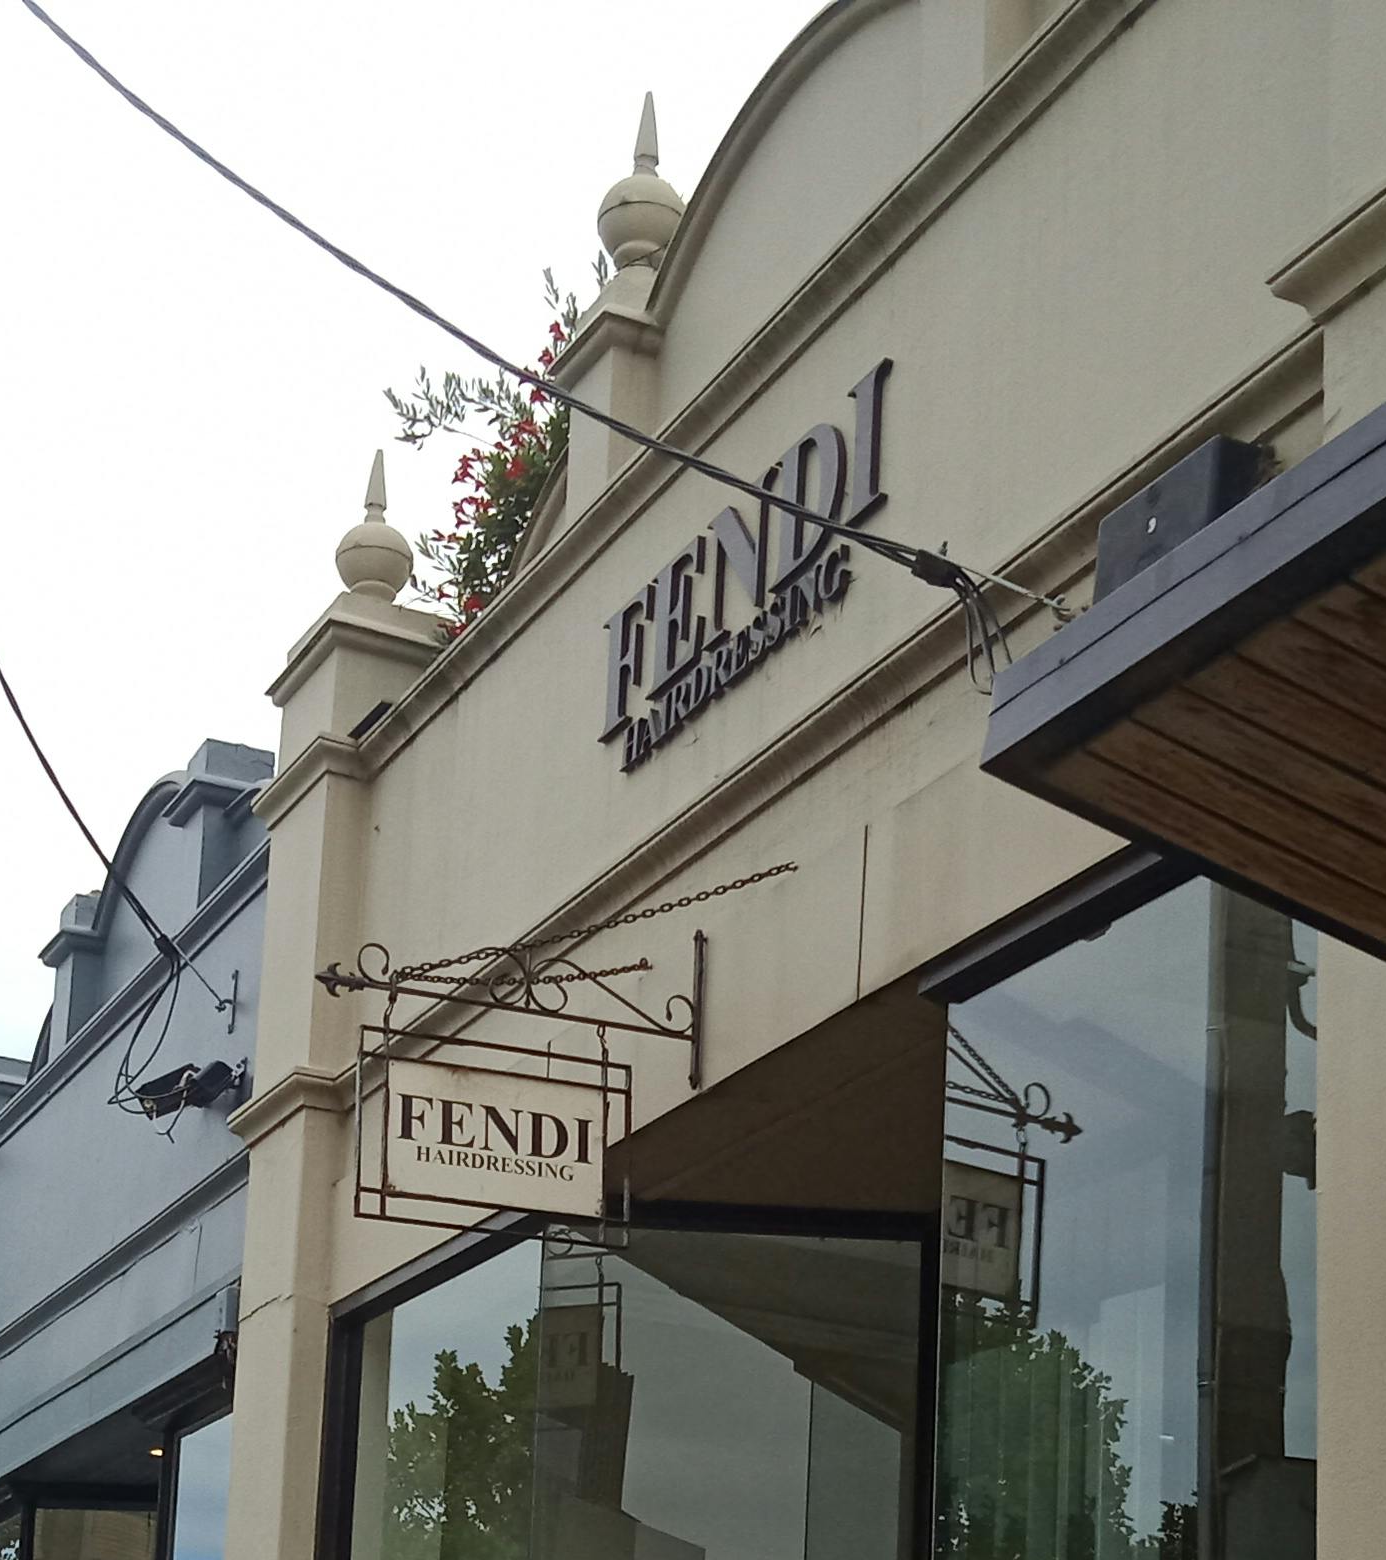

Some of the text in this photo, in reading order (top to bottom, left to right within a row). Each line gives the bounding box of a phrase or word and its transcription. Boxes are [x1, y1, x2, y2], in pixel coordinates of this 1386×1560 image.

[597, 357, 894, 744] FENDI
[620, 544, 853, 774] HAIRDRESSING
[397, 1092, 593, 1165] FENDI
[416, 1145, 574, 1182] HAIRDRESSING
